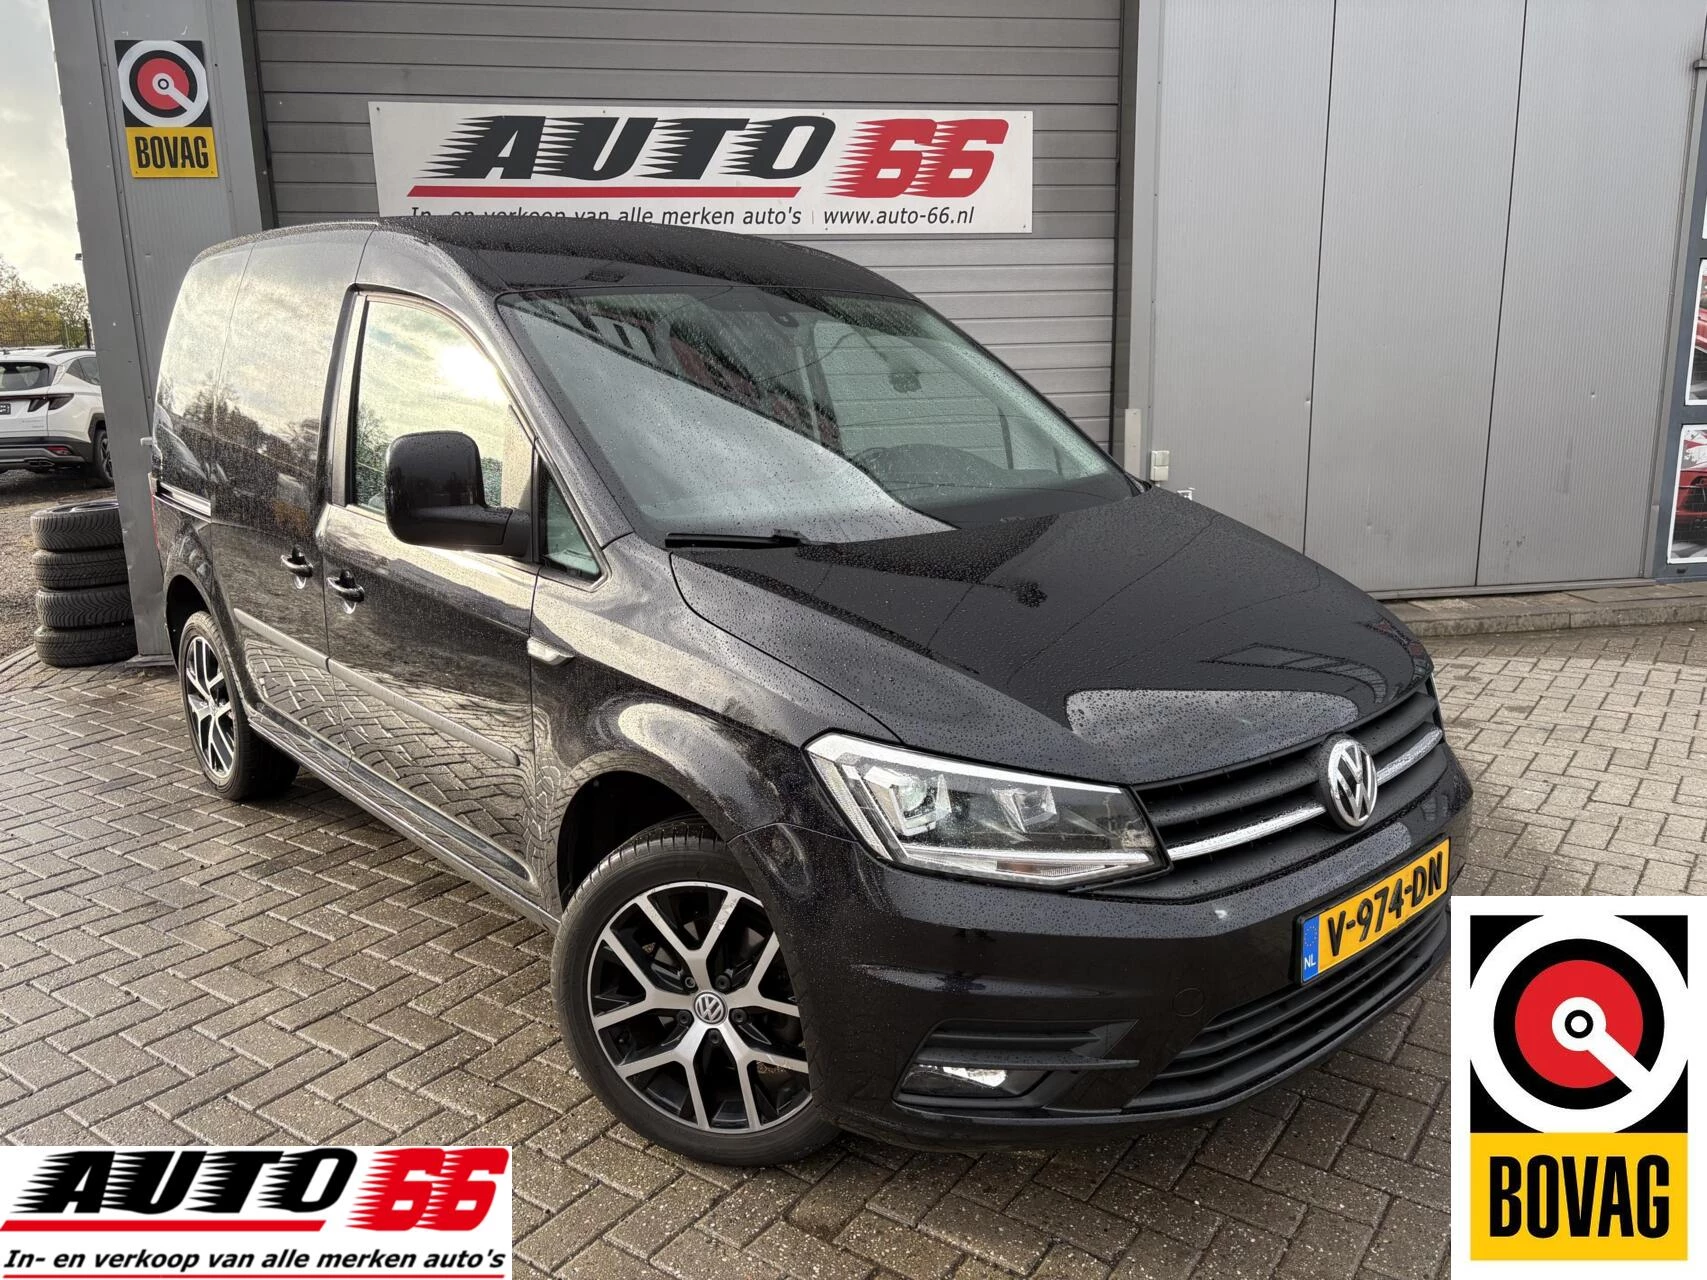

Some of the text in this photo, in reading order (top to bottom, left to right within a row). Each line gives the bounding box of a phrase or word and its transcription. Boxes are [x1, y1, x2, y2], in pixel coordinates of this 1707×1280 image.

[134, 136, 209, 169] BOVAG
[412, 115, 1009, 198] AUTO 66
[619, 206, 653, 223] alle
[661, 206, 735, 225] merken
[742, 206, 802, 225] auto's
[823, 206, 975, 225] www.auto-66.nl
[1327, 851, 1443, 957] V-974-DN
[1304, 955, 1317, 970] NL
